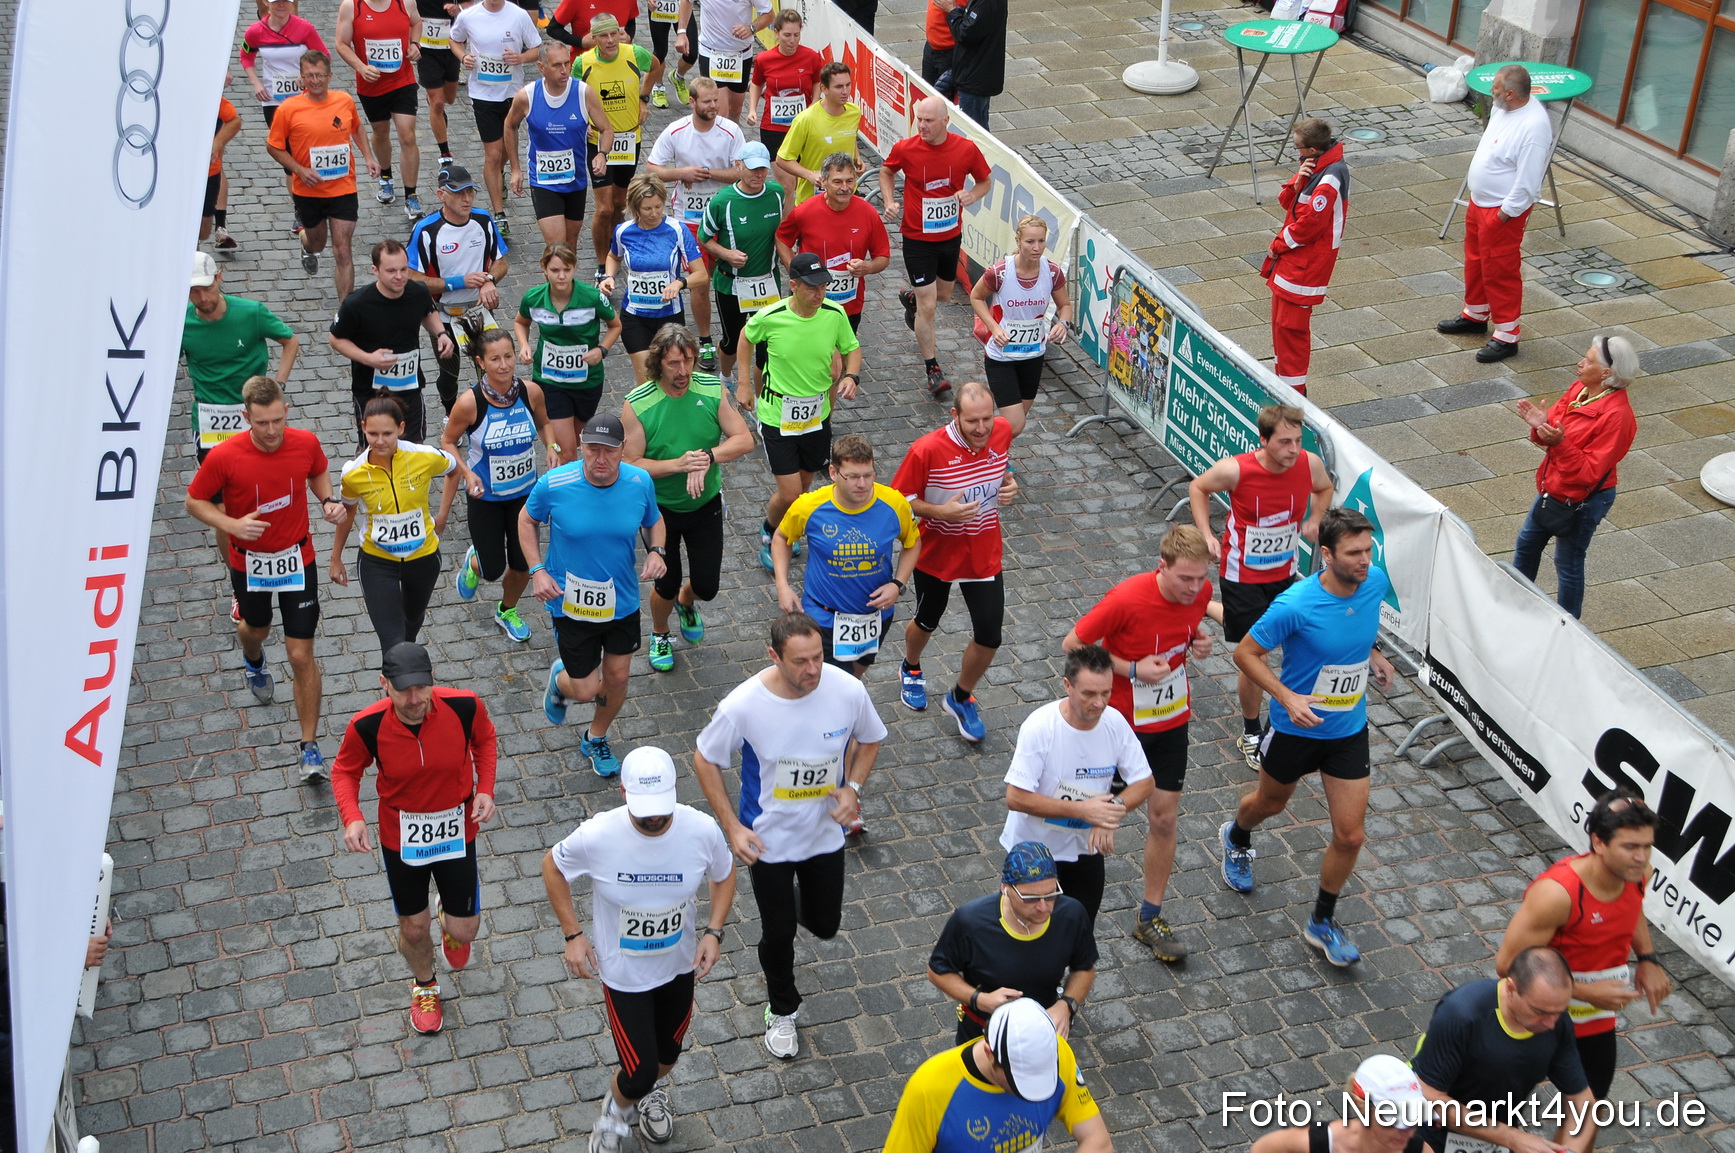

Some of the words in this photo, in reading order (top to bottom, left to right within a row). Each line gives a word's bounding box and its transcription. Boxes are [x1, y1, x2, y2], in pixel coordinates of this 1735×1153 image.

[657, 1, 676, 13] 240
[427, 26, 441, 38] 37
[370, 47, 400, 60] 2216
[481, 61, 511, 73] 3332
[716, 58, 736, 70] 302
[775, 103, 803, 117] 2230
[614, 140, 628, 152] 00
[315, 154, 347, 168] 2145
[539, 158, 571, 173] 2923
[687, 197, 711, 210] 234
[927, 203, 957, 220] 2038
[632, 280, 666, 295] 2936
[750, 282, 767, 297] 10
[826, 277, 855, 292] 2231
[1009, 328, 1040, 343] 2773
[546, 352, 584, 369] 2690
[95, 297, 148, 501] BKK
[1174, 372, 1208, 412] Mehr
[1206, 400, 1261, 455] Sicherhe
[210, 415, 242, 430] 222
[1172, 399, 1190, 421] für
[1192, 416, 1208, 443] Ihr
[1209, 432, 1232, 459] Eve
[494, 423, 530, 438] NAGEL
[1170, 432, 1186, 455] Miet
[1188, 449, 1196, 461] &
[495, 458, 533, 482] 3369
[963, 483, 991, 503] VPV
[377, 520, 420, 543] 2446
[1251, 534, 1292, 554] 2227
[252, 556, 298, 576] 2180
[260, 577, 293, 587] Christian
[566, 575, 581, 586] PARTL
[581, 582, 608, 591] Neumarkt
[573, 588, 606, 607] 168
[573, 607, 602, 617] Michael
[1380, 605, 1401, 629] GmbH
[839, 620, 877, 642] 2815
[64, 543, 130, 767] Audi
[1330, 674, 1360, 694] 100
[1152, 684, 1174, 705] 74
[1152, 705, 1175, 717] Simon
[1429, 666, 1471, 717] istungen,
[1471, 711, 1485, 732] die
[1485, 725, 1536, 782] verbinden
[777, 759, 799, 768] PARTL
[790, 769, 828, 787] 192
[788, 789, 822, 799] Gerhard
[1058, 785, 1080, 797] PARTL
[424, 812, 455, 821] Neumarkt
[407, 818, 459, 844] 2845
[416, 844, 451, 858] Matthias
[637, 873, 683, 883] BÜSCHEL
[621, 908, 645, 918] PARTL
[646, 907, 678, 918] Neumarkt
[626, 912, 682, 938] 2649
[643, 940, 665, 950] Jens
